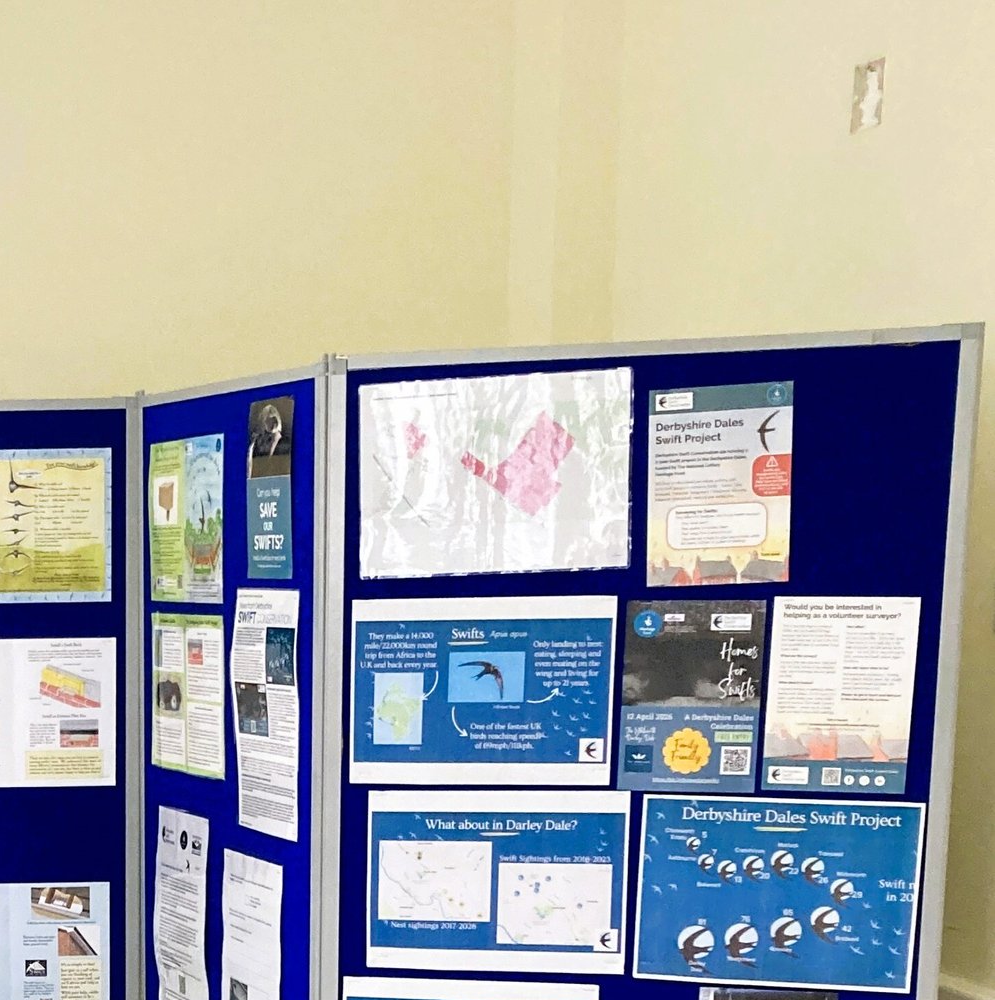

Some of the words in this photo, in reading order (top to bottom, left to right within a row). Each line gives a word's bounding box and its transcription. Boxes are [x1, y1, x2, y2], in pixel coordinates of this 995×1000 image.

[655, 420, 711, 432] Derbyshire
[714, 418, 744, 428] Dales
[655, 435, 682, 445] Swift
[684, 433, 721, 444] Project
[259, 502, 278, 518] SAVE
[263, 521, 273, 531] OUR
[254, 534, 284, 550] SWIFTS?
[238, 611, 257, 624] SWIFT
[783, 612, 811, 620] helping
[368, 632, 384, 641] They
[386, 632, 405, 640] make
[451, 627, 485, 639] Swifts
[417, 641, 438, 649] round
[532, 640, 551, 649] Only
[551, 640, 577, 649] landing
[720, 637, 759, 662] Homes
[364, 652, 377, 660] trip
[378, 651, 394, 659] from
[396, 651, 416, 659] Africa
[425, 651, 437, 659] the
[558, 651, 587, 659] sleeping
[587, 650, 602, 658] and
[373, 661, 386, 669] and
[403, 662, 421, 670] every
[535, 670, 553, 678] wing
[553, 669, 567, 677] and
[567, 669, 588, 678] living
[588, 669, 599, 677] for
[542, 680, 553, 688] up
[718, 677, 759, 701] Swifts
[636, 713, 654, 722] April
[692, 713, 732, 722] Derbyshire
[733, 713, 754, 721] Dales
[470, 722, 484, 730] One
[494, 722, 506, 730] the
[507, 722, 529, 730] fastest
[530, 722, 542, 730] UK
[710, 722, 753, 730] Celebration
[487, 732, 518, 741] reaching
[682, 806, 762, 824] Derbyshire
[765, 809, 806, 824] Dales
[809, 811, 847, 826] Swift
[850, 812, 902, 831] Project
[425, 818, 457, 829] What
[458, 819, 491, 830] about
[492, 820, 503, 830] in
[506, 820, 543, 833] Darley
[545, 820, 578, 831] Dale?
[499, 854, 517, 862] Swift
[518, 855, 552, 864] Sightings
[553, 855, 571, 863] from
[878, 879, 905, 889] Swift
[886, 892, 897, 901] in
[391, 921, 406, 929] Nest
[408, 921, 439, 931] sightings
